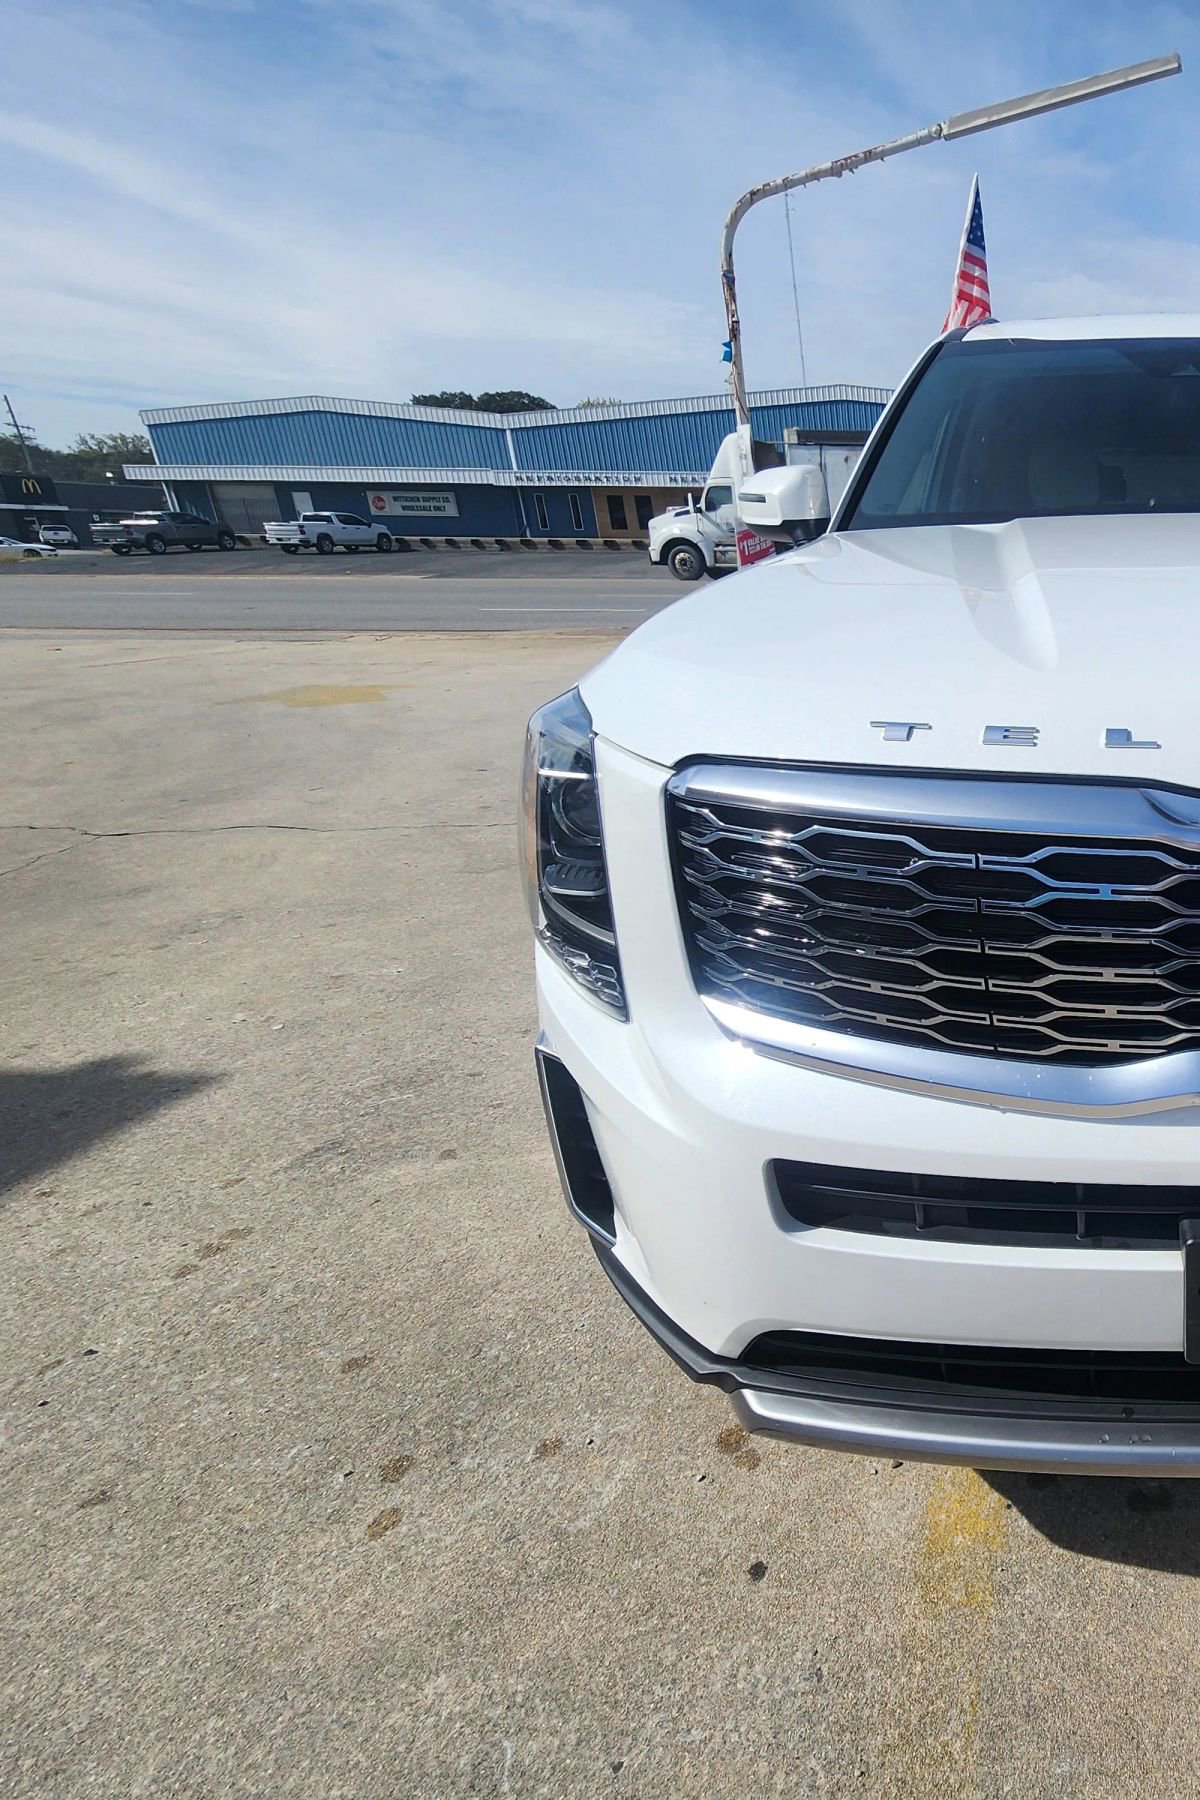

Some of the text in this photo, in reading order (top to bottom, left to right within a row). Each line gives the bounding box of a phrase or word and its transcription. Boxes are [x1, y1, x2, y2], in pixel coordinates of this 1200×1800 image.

[514, 474, 642, 483] REFRIGERATION
[421, 495, 441, 503] SUPPLY
[400, 504, 432, 512] WHOLESALE
